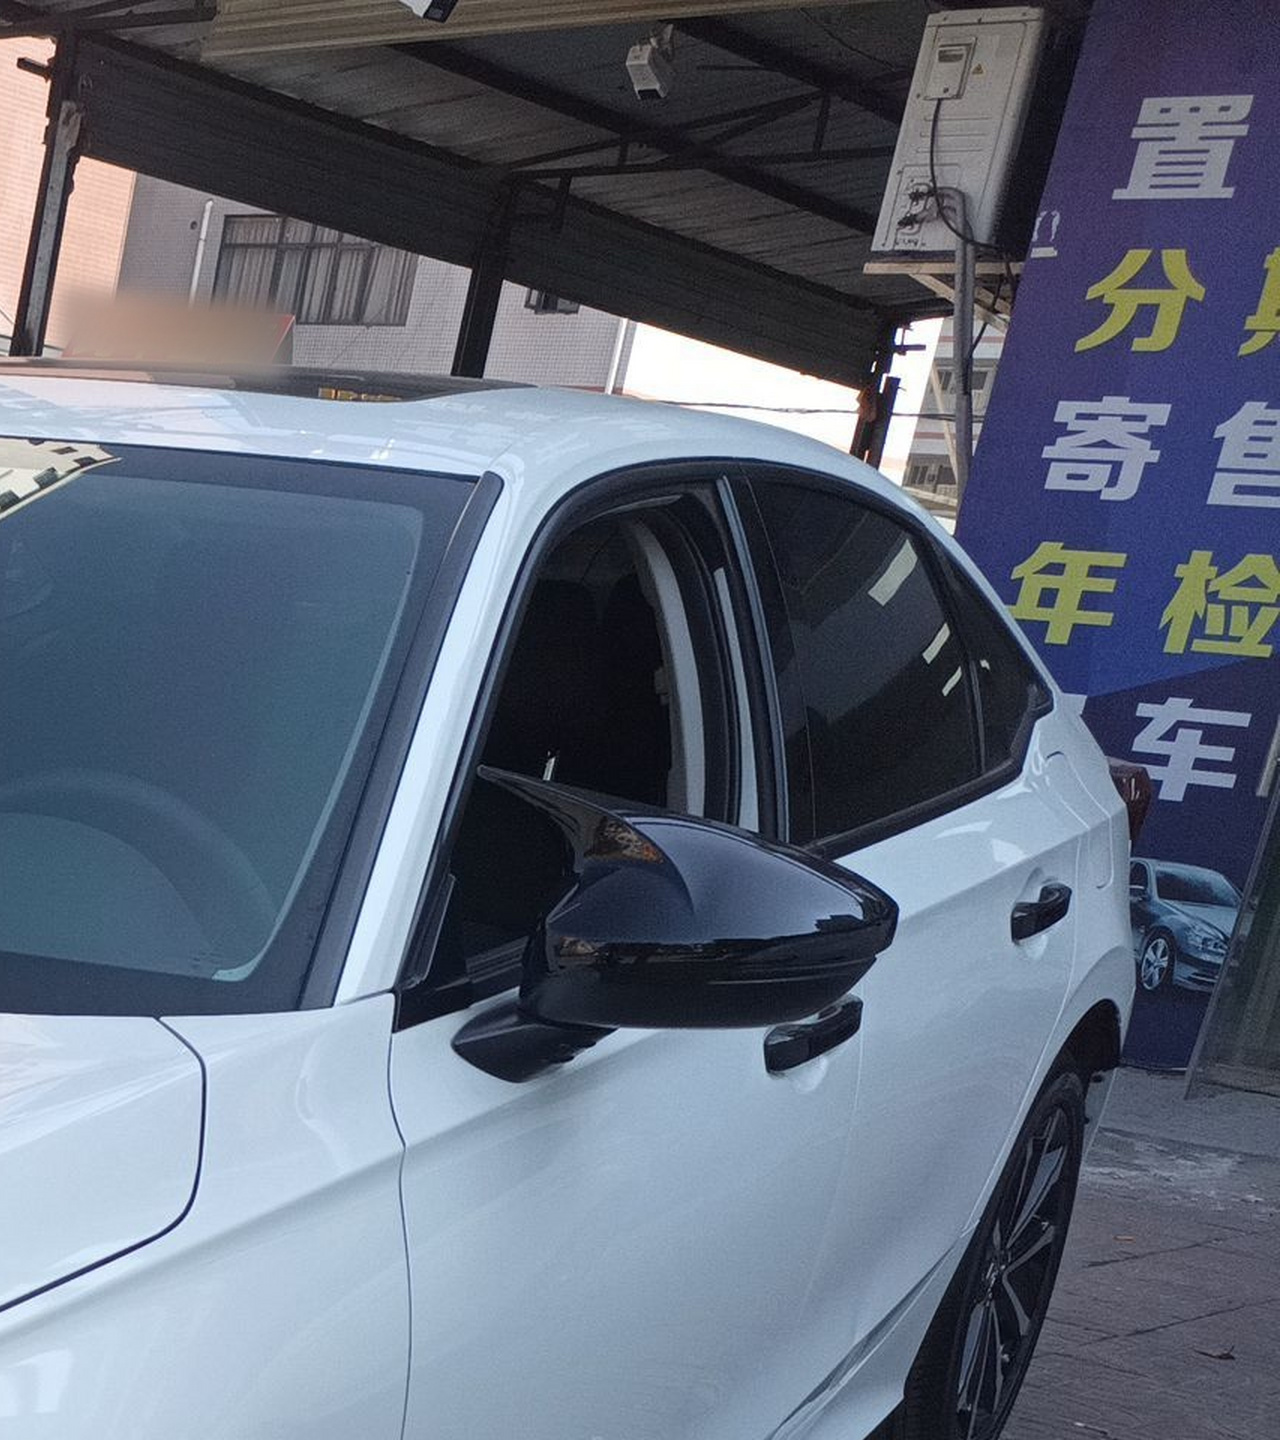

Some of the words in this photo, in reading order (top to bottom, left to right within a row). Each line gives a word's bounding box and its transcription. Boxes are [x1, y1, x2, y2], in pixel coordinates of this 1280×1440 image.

[1111, 94, 1254, 200] 置
[1041, 395, 1280, 509] 寄售
[1007, 541, 1280, 658] 年检
